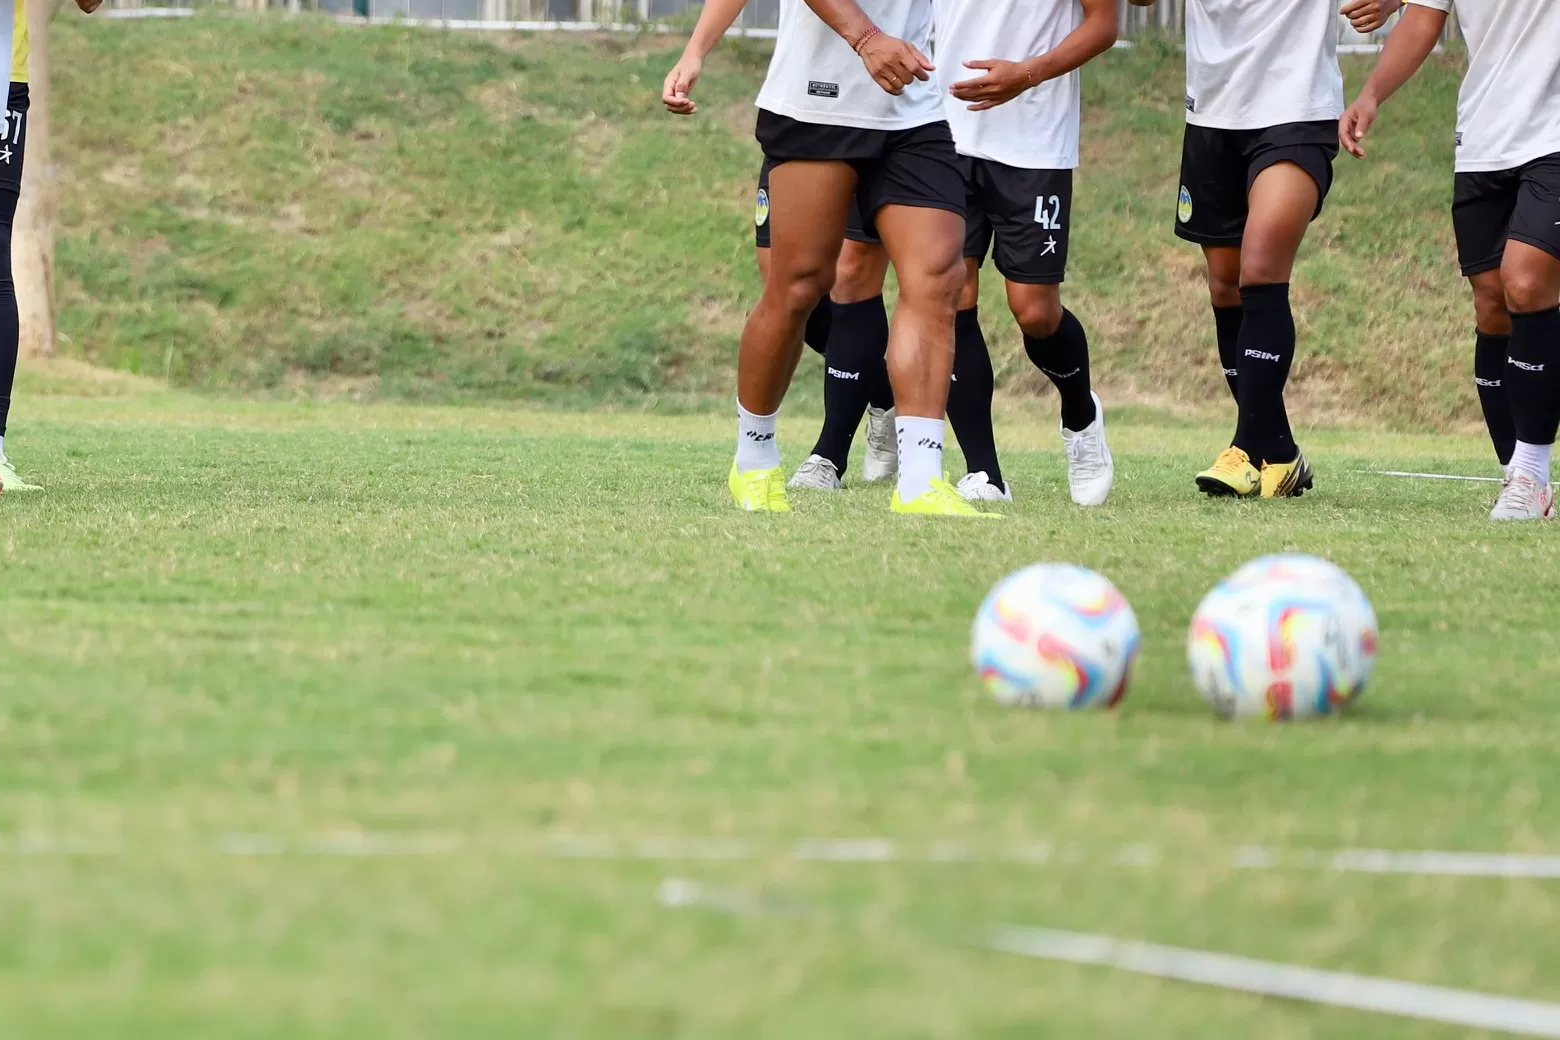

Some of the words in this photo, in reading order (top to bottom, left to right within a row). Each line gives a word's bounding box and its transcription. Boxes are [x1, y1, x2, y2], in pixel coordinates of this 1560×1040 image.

[1034, 194, 1061, 230] 42
[1244, 348, 1280, 362] PSIM
[828, 366, 860, 380] PSIM
